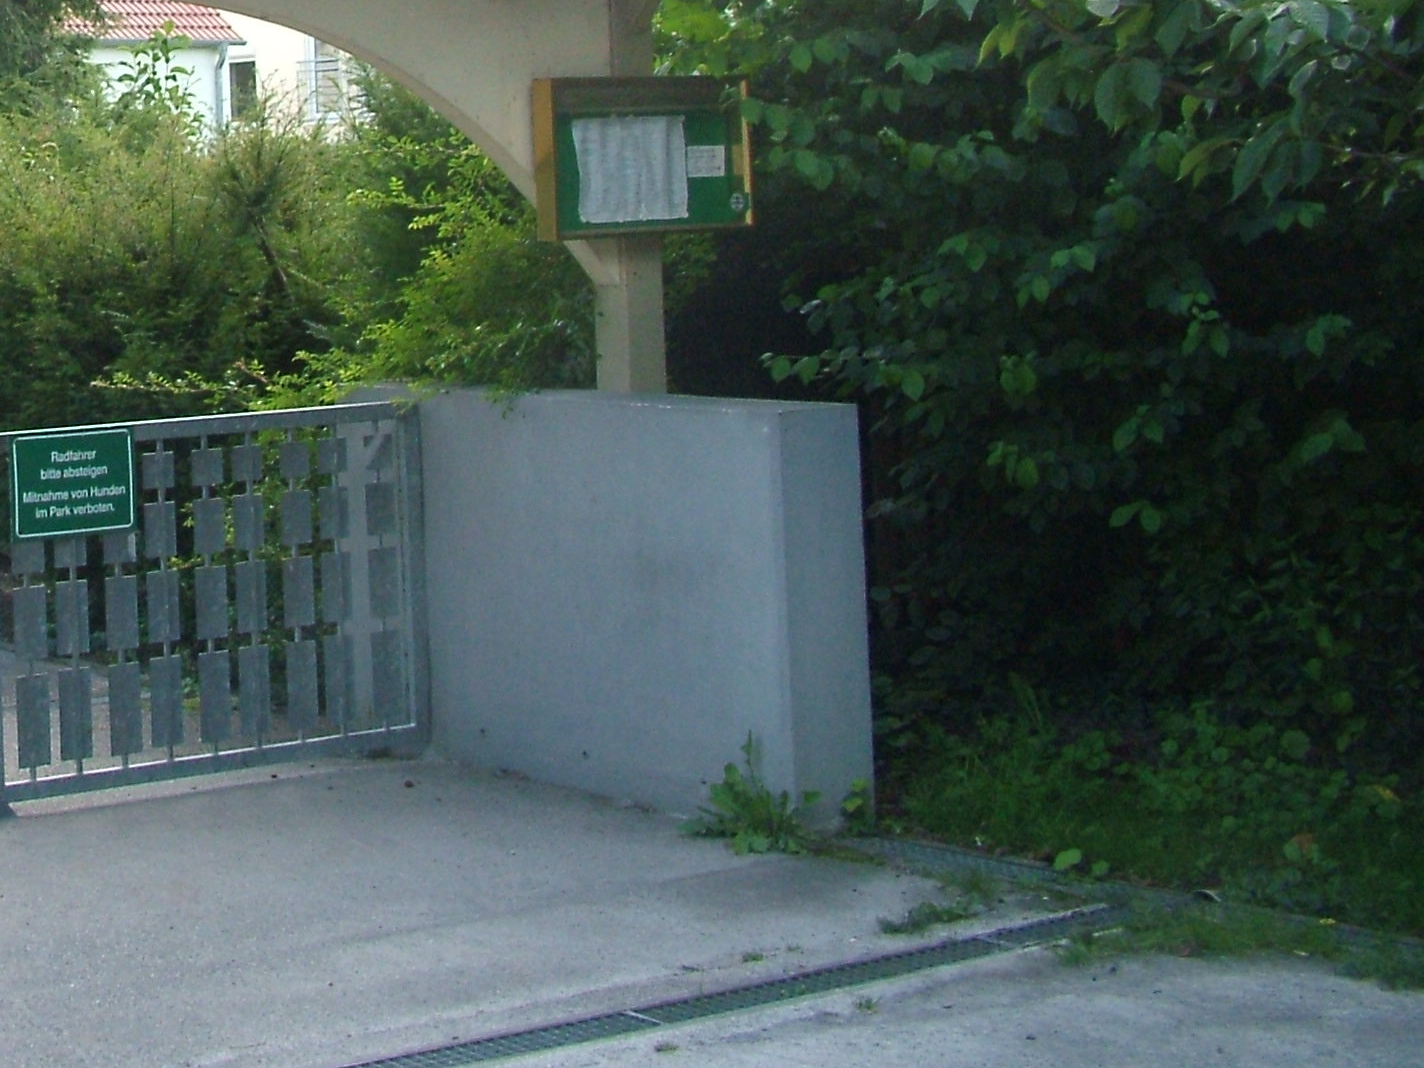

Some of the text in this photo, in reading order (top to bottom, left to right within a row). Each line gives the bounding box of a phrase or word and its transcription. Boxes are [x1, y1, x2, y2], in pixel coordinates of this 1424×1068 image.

[50, 449, 97, 463] Radfahrer
[40, 465, 108, 480] bitte absteigen
[23, 485, 126, 503] Mitnahme von Hunden
[36, 507, 48, 518] im
[49, 505, 71, 518] Park
